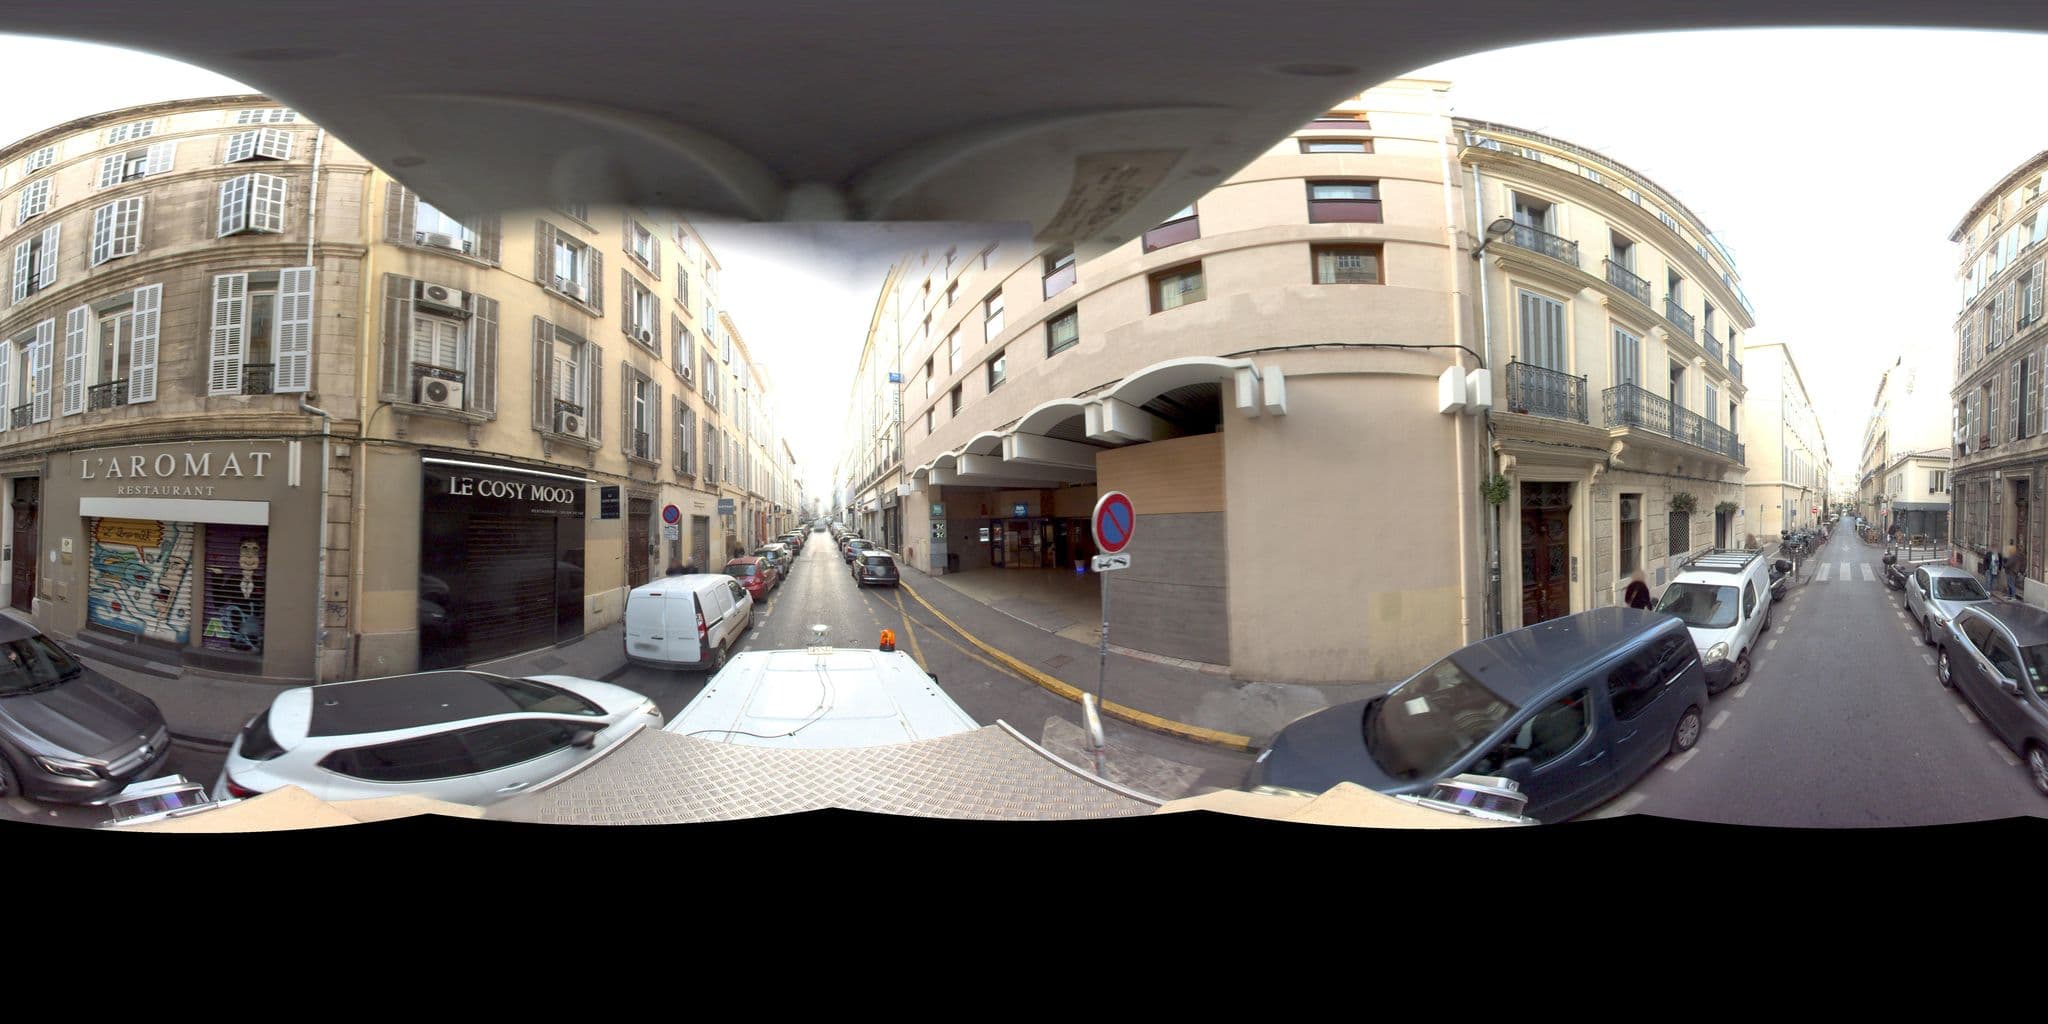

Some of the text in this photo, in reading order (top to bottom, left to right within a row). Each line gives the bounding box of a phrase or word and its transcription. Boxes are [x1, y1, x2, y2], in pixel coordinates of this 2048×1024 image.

[80, 451, 272, 479] L'AROMAT
[118, 485, 215, 497] RESTAURANT
[449, 477, 473, 496] LE
[478, 480, 526, 500] COSY
